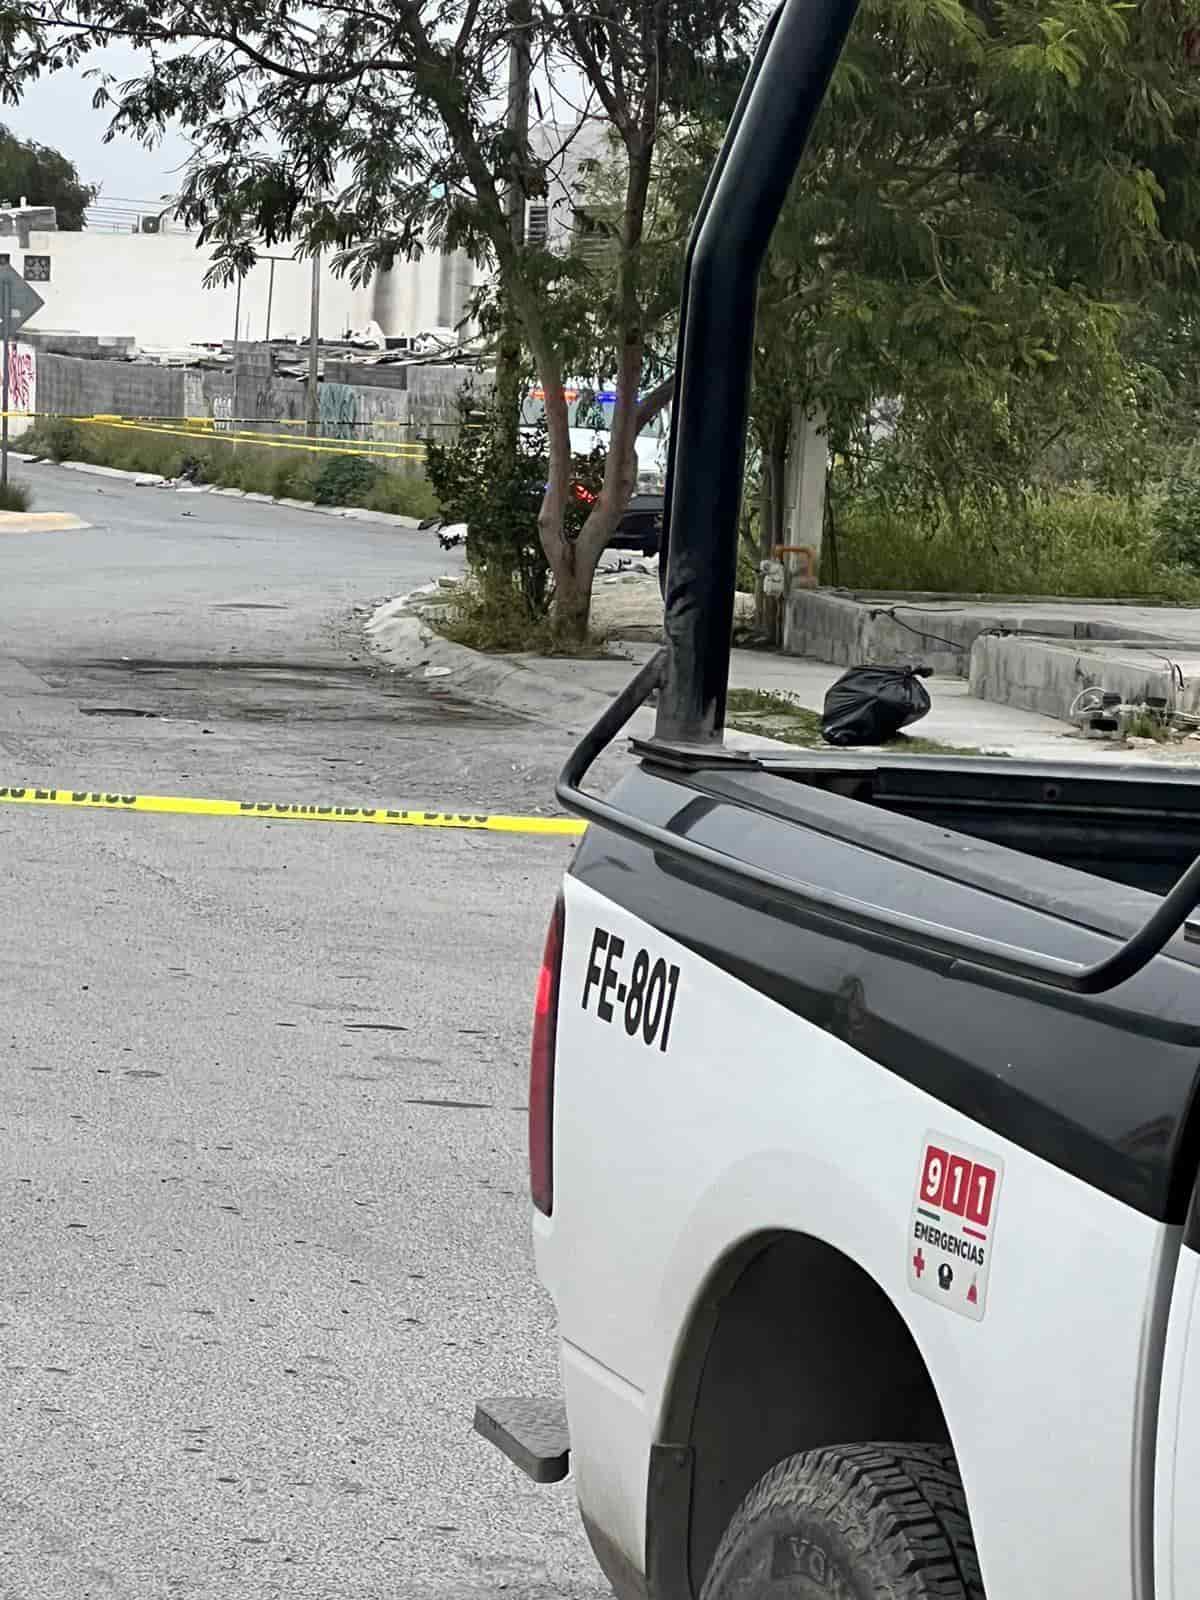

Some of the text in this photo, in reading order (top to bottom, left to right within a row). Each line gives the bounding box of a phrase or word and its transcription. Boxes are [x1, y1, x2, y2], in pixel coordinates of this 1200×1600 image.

[581, 927, 680, 1052] FE-801
[924, 1156, 990, 1217] 911
[914, 1221, 985, 1267] EMERGENCIAS
